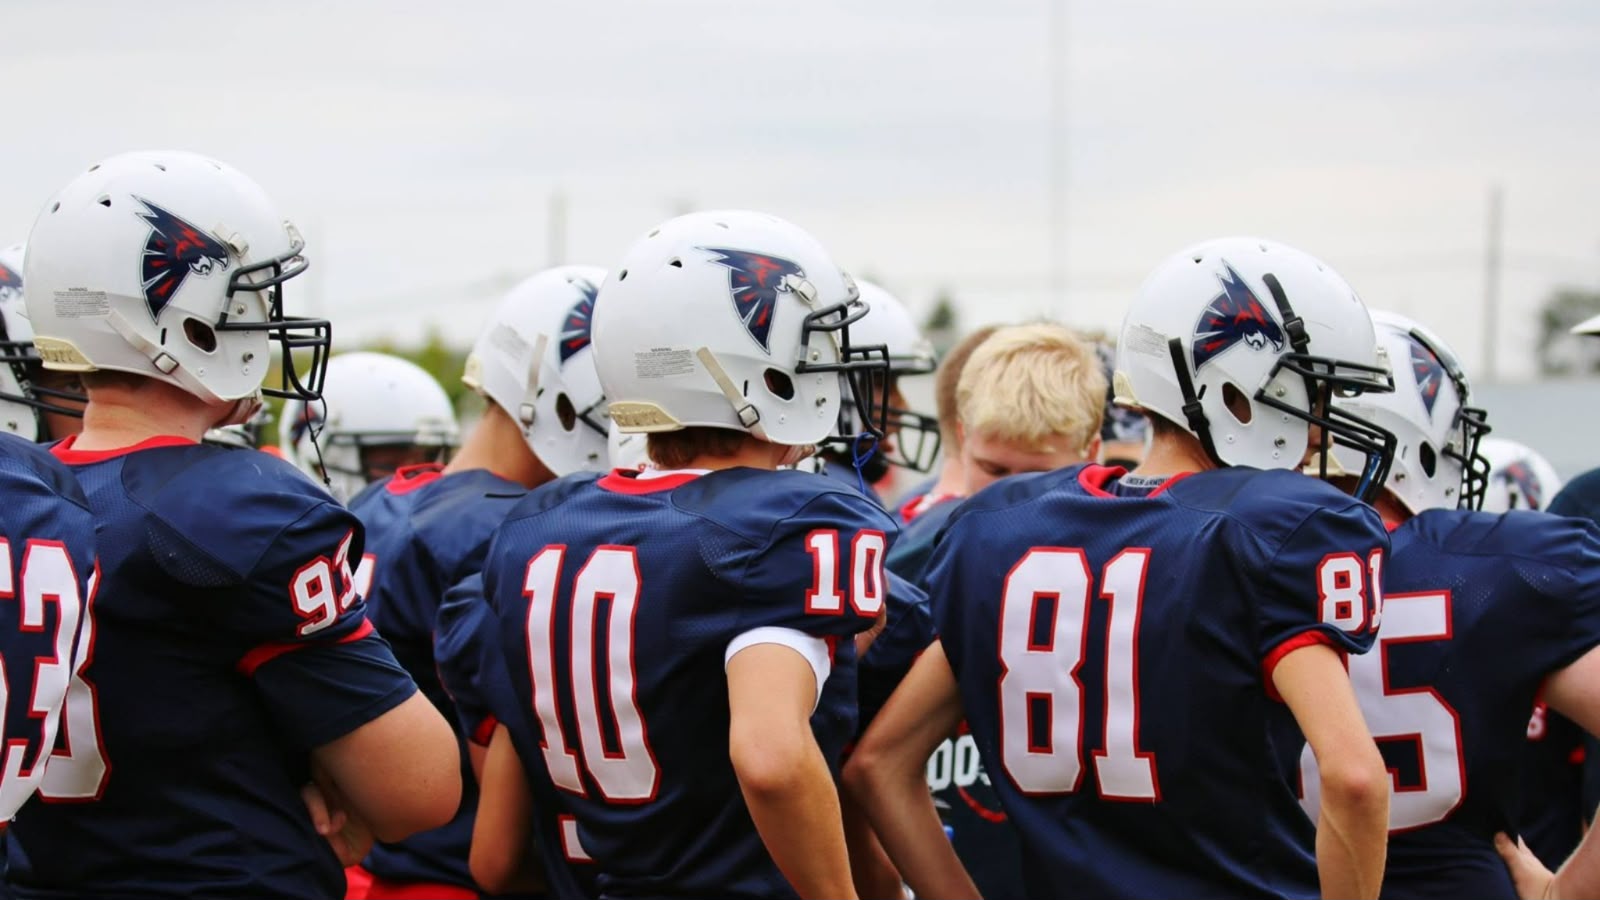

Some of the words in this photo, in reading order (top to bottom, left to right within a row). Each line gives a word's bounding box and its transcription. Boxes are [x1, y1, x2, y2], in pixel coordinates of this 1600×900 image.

[805, 528, 886, 618] 10
[1316, 548, 1384, 635] 81
[522, 544, 661, 804] 10
[998, 546, 1161, 803] 81
